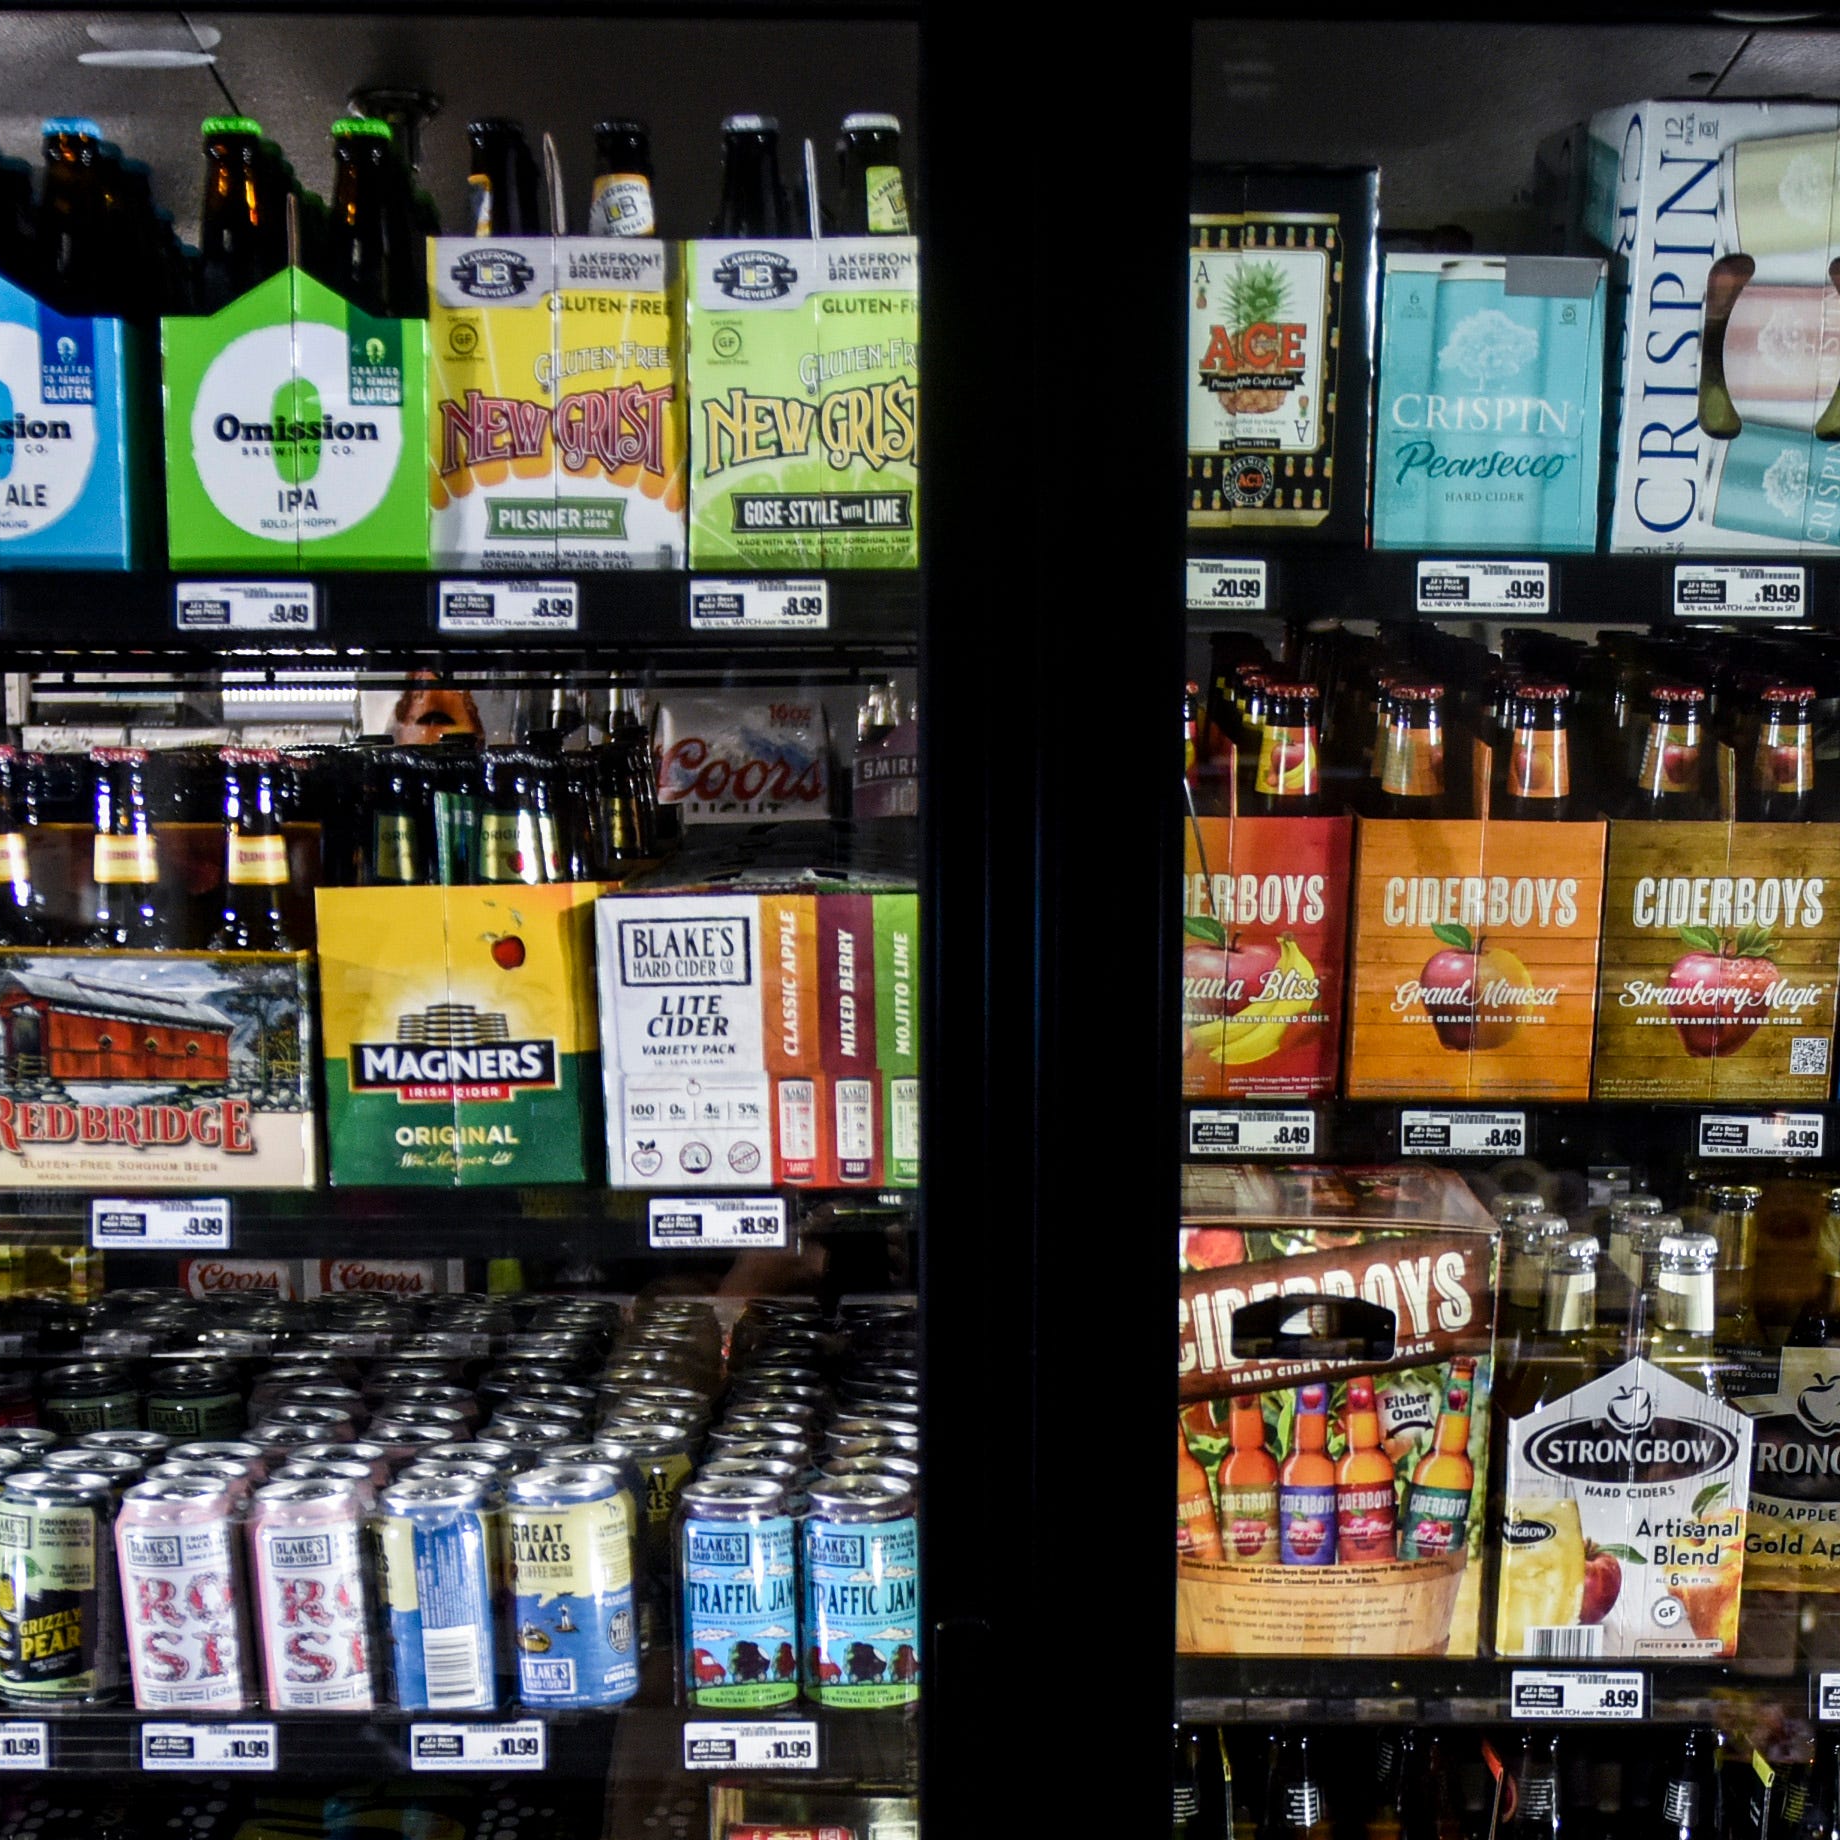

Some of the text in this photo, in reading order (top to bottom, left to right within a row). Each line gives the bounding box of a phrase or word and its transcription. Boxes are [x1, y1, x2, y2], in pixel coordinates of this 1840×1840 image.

[569, 253, 661, 265] LAKEFRONT
[569, 266, 640, 280] BREWERY
[1633, 152, 1721, 534] CRISPIN
[1392, 393, 1570, 434] CRISPIN
[440, 381, 675, 478] NEW GRIST
[1395, 440, 1577, 484] Pearsecco
[6, 484, 47, 507] ALE
[276, 488, 319, 514] IPA
[1444, 491, 1525, 503] HARD CIDER
[498, 506, 581, 530] PILSNER
[742, 497, 902, 526] GOSE-STYLE WITH LIME
[1755, 584, 1800, 603] $19.99
[532, 598, 572, 620] $8.99
[1713, 604, 1742, 612] MATCH
[1383, 876, 1578, 928] CIDERBOYS
[1633, 876, 1824, 929] CIDERBOYS
[632, 926, 735, 959] BLAKE'S
[632, 962, 716, 978] HARD CIDER
[779, 910, 799, 1056] CLASSIC APPLE
[660, 995, 722, 1016] LITE
[838, 929, 857, 1058] MIXED BERRY
[1389, 979, 1559, 1013] Grand Mimosa
[1618, 979, 1821, 1013] Strawberry Magic
[646, 1016, 730, 1037] CIDER
[641, 1043, 737, 1056] VARIETY PACK
[362, 1044, 542, 1083] MAGNERS
[395, 1124, 519, 1147] ORIGINAL
[1547, 1435, 1716, 1465] STRONGBOW
[1634, 1516, 1740, 1540] Artisanal
[1652, 1543, 1720, 1567] Blend
[689, 1580, 793, 1614] TRAFFIC JAM
